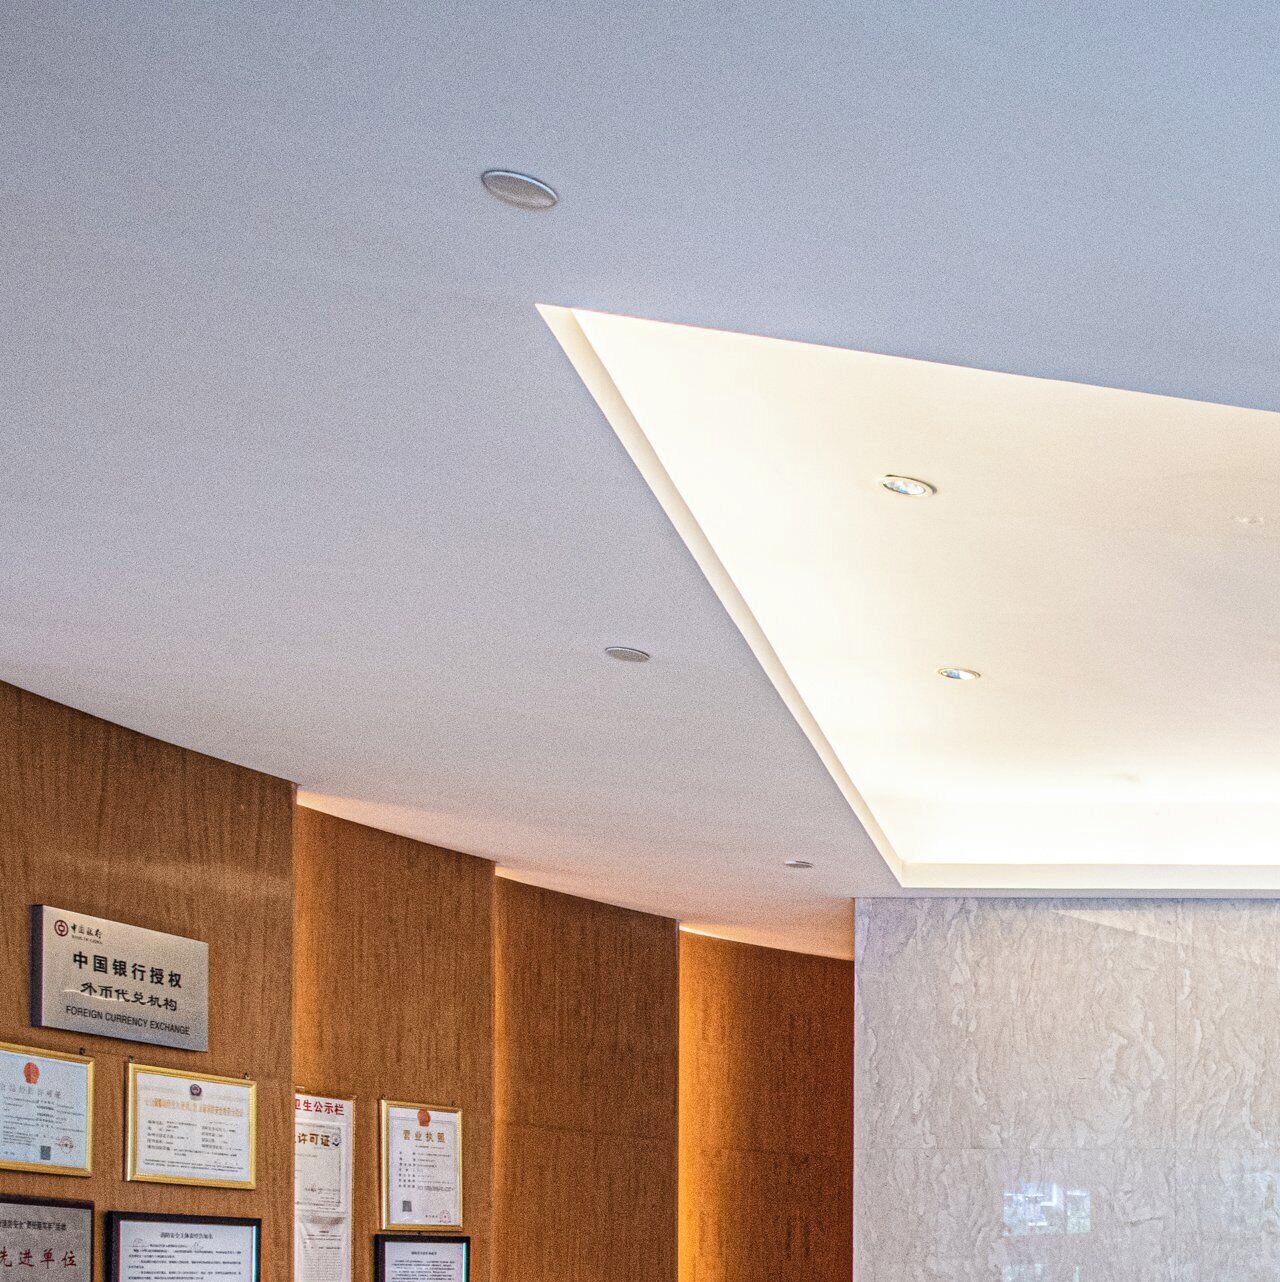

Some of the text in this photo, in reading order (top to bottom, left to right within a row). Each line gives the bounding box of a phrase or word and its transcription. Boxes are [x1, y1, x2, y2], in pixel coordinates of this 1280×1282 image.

[73, 951, 182, 988] 中国银行授权
[80, 982, 177, 1012] 外币代兑机构
[66, 1005, 190, 1036] FOREIGN CURRENCY EXCHANGE
[295, 1133, 331, 1147] 许可证
[403, 1130, 446, 1143] 营业执照
[0, 1246, 77, 1269] 先进单位
